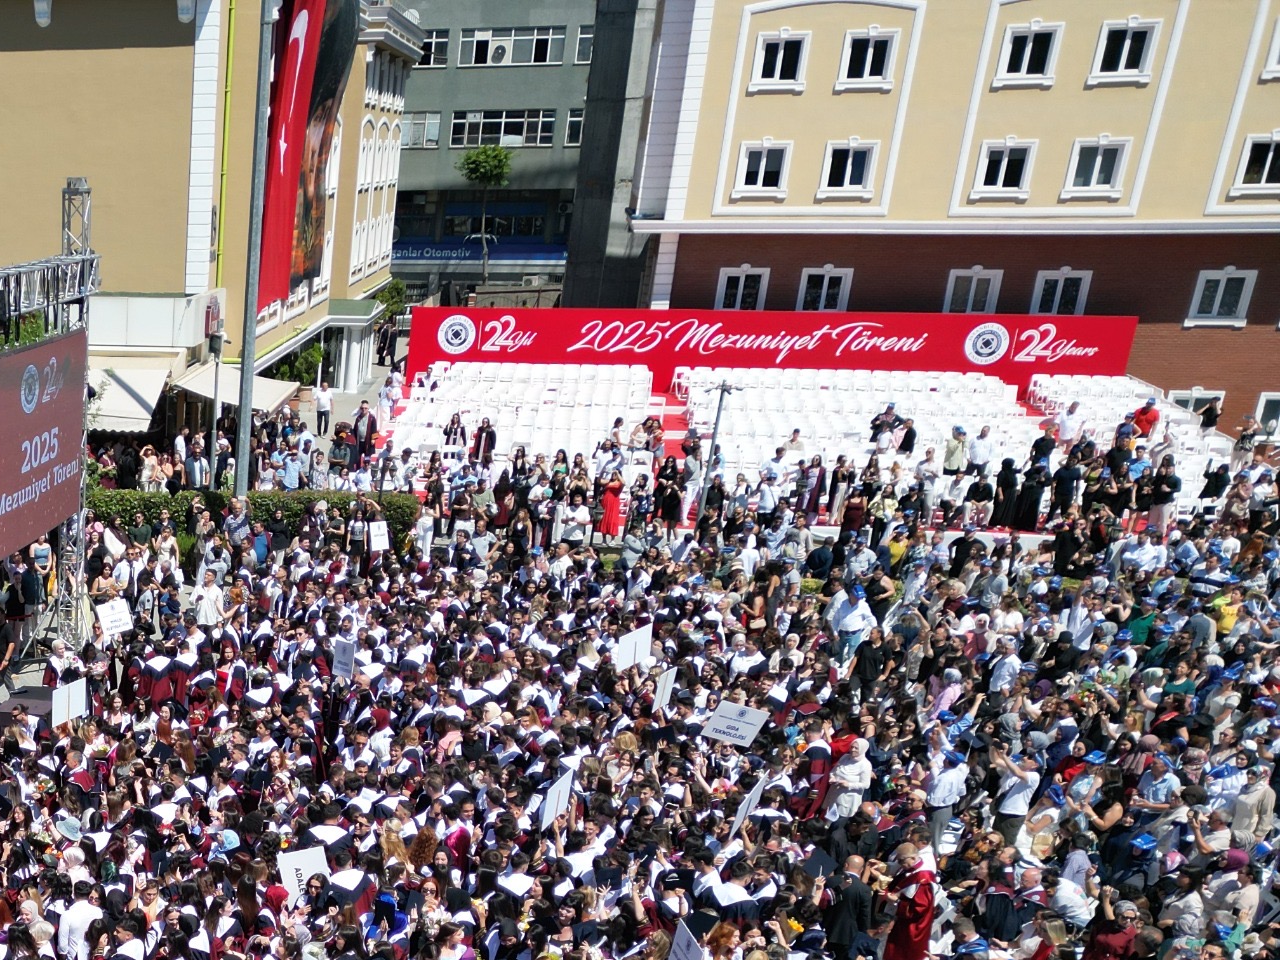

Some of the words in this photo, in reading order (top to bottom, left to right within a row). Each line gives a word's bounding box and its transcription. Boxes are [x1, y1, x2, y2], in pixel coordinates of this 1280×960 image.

[423, 247, 471, 257] Otomotiv
[481, 315, 516, 351] 22
[507, 330, 537, 352] Yıl
[567, 320, 669, 352] 2025
[666, 318, 833, 363] Mezuniyet
[832, 321, 928, 356] Töreni
[1014, 323, 1056, 362] 22
[1047, 339, 1099, 362] Years
[21, 426, 58, 474] 2025
[53, 453, 79, 485] Töreni
[294, 867, 307, 896] ADALE
